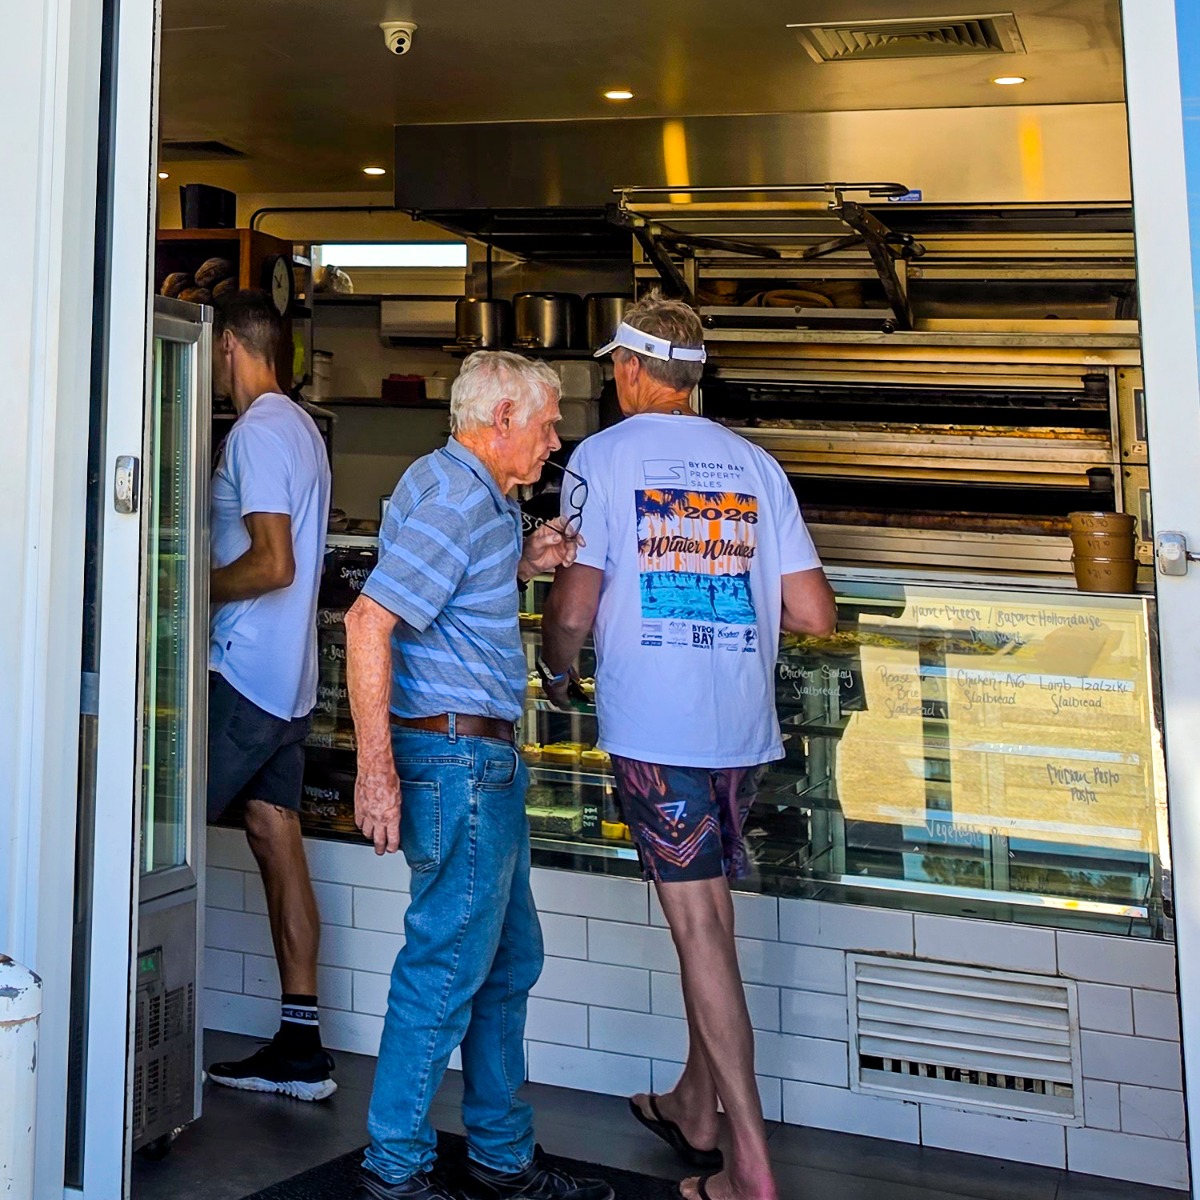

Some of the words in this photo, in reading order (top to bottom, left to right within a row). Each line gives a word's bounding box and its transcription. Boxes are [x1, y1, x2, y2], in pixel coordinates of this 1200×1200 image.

[689, 461, 723, 469] BYRON
[727, 463, 744, 472] BAY
[690, 470, 741, 479] PROPERTY
[691, 480, 722, 488] SALES
[683, 506, 759, 524] 2026
[647, 535, 701, 558] Winter
[692, 632, 715, 646] BAY
[780, 664, 815, 683] Chicken
